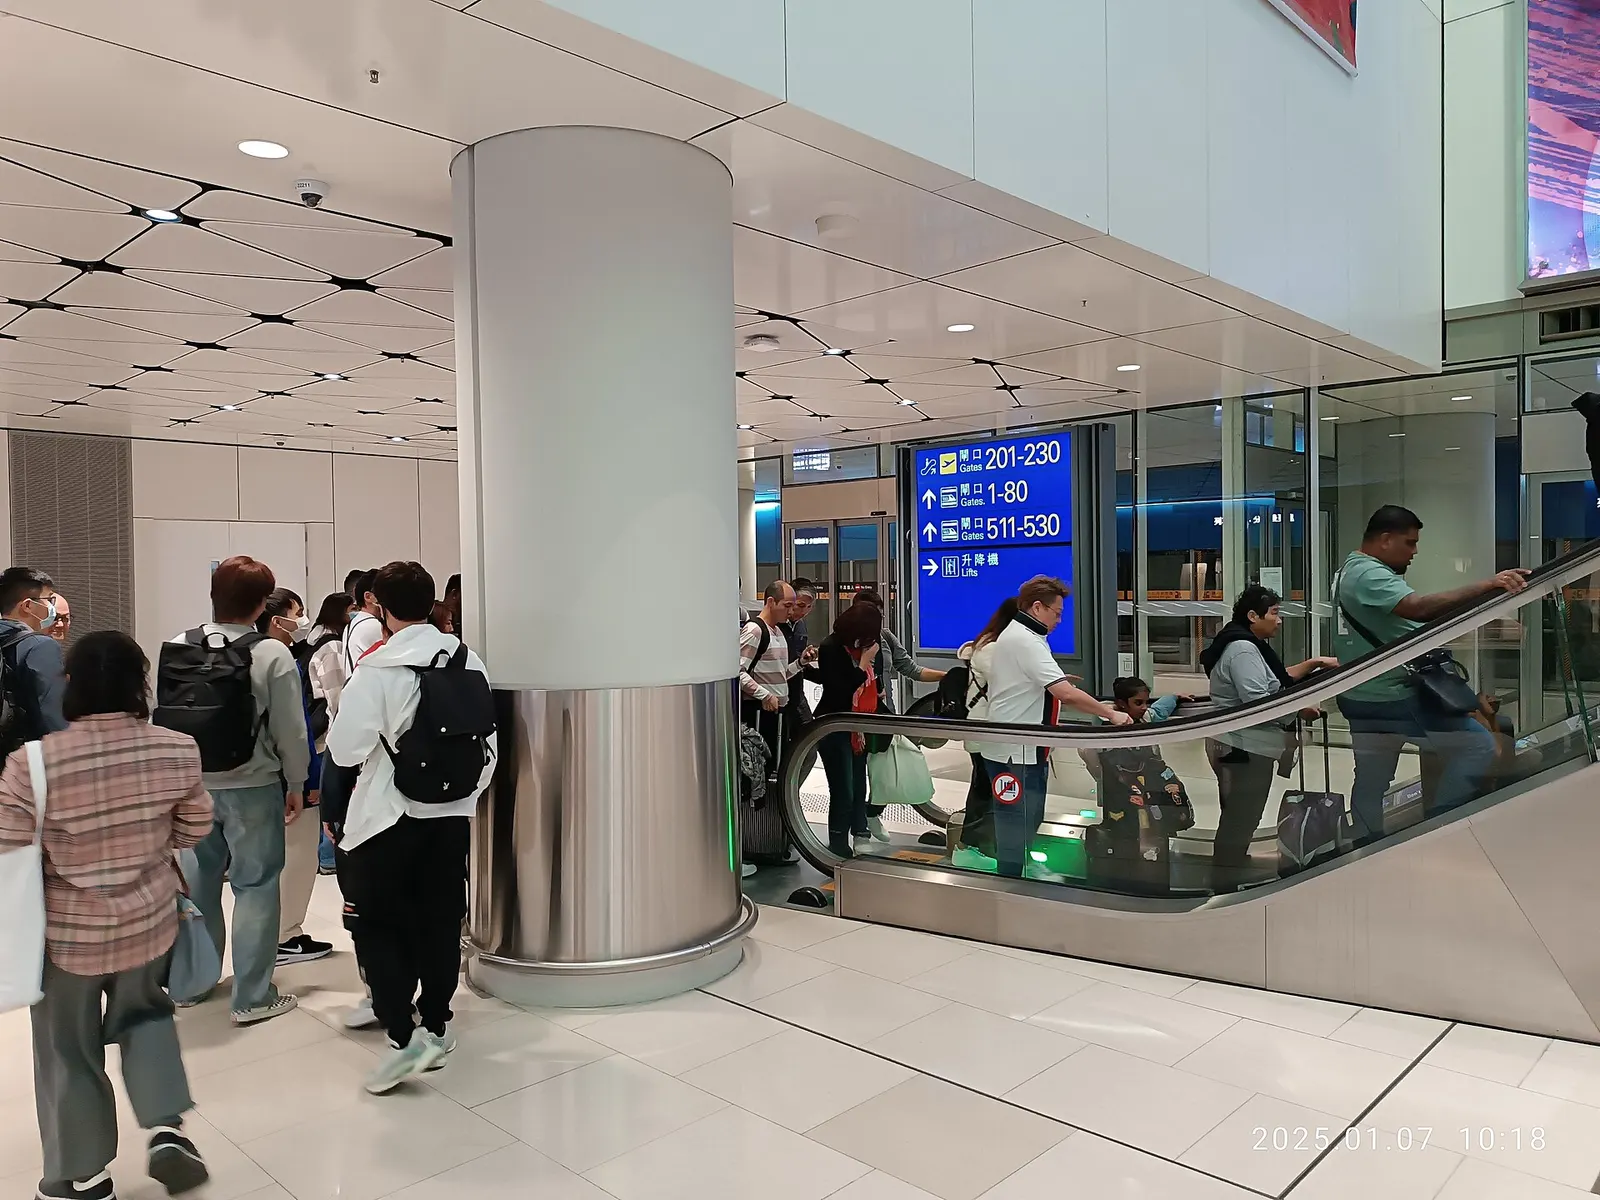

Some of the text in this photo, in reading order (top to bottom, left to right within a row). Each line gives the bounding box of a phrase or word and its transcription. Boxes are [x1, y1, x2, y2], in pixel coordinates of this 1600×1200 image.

[959, 449, 982, 462] 閘口
[985, 440, 1061, 470] 201-230
[959, 463, 983, 473] Gates
[960, 483, 983, 497] 閘口
[987, 480, 1028, 504] 1-80
[961, 517, 984, 530] 閘口
[986, 513, 1060, 540] 511-530
[961, 532, 985, 541] Gates
[961, 552, 999, 567] 升降機
[961, 568, 978, 577] Lifts
